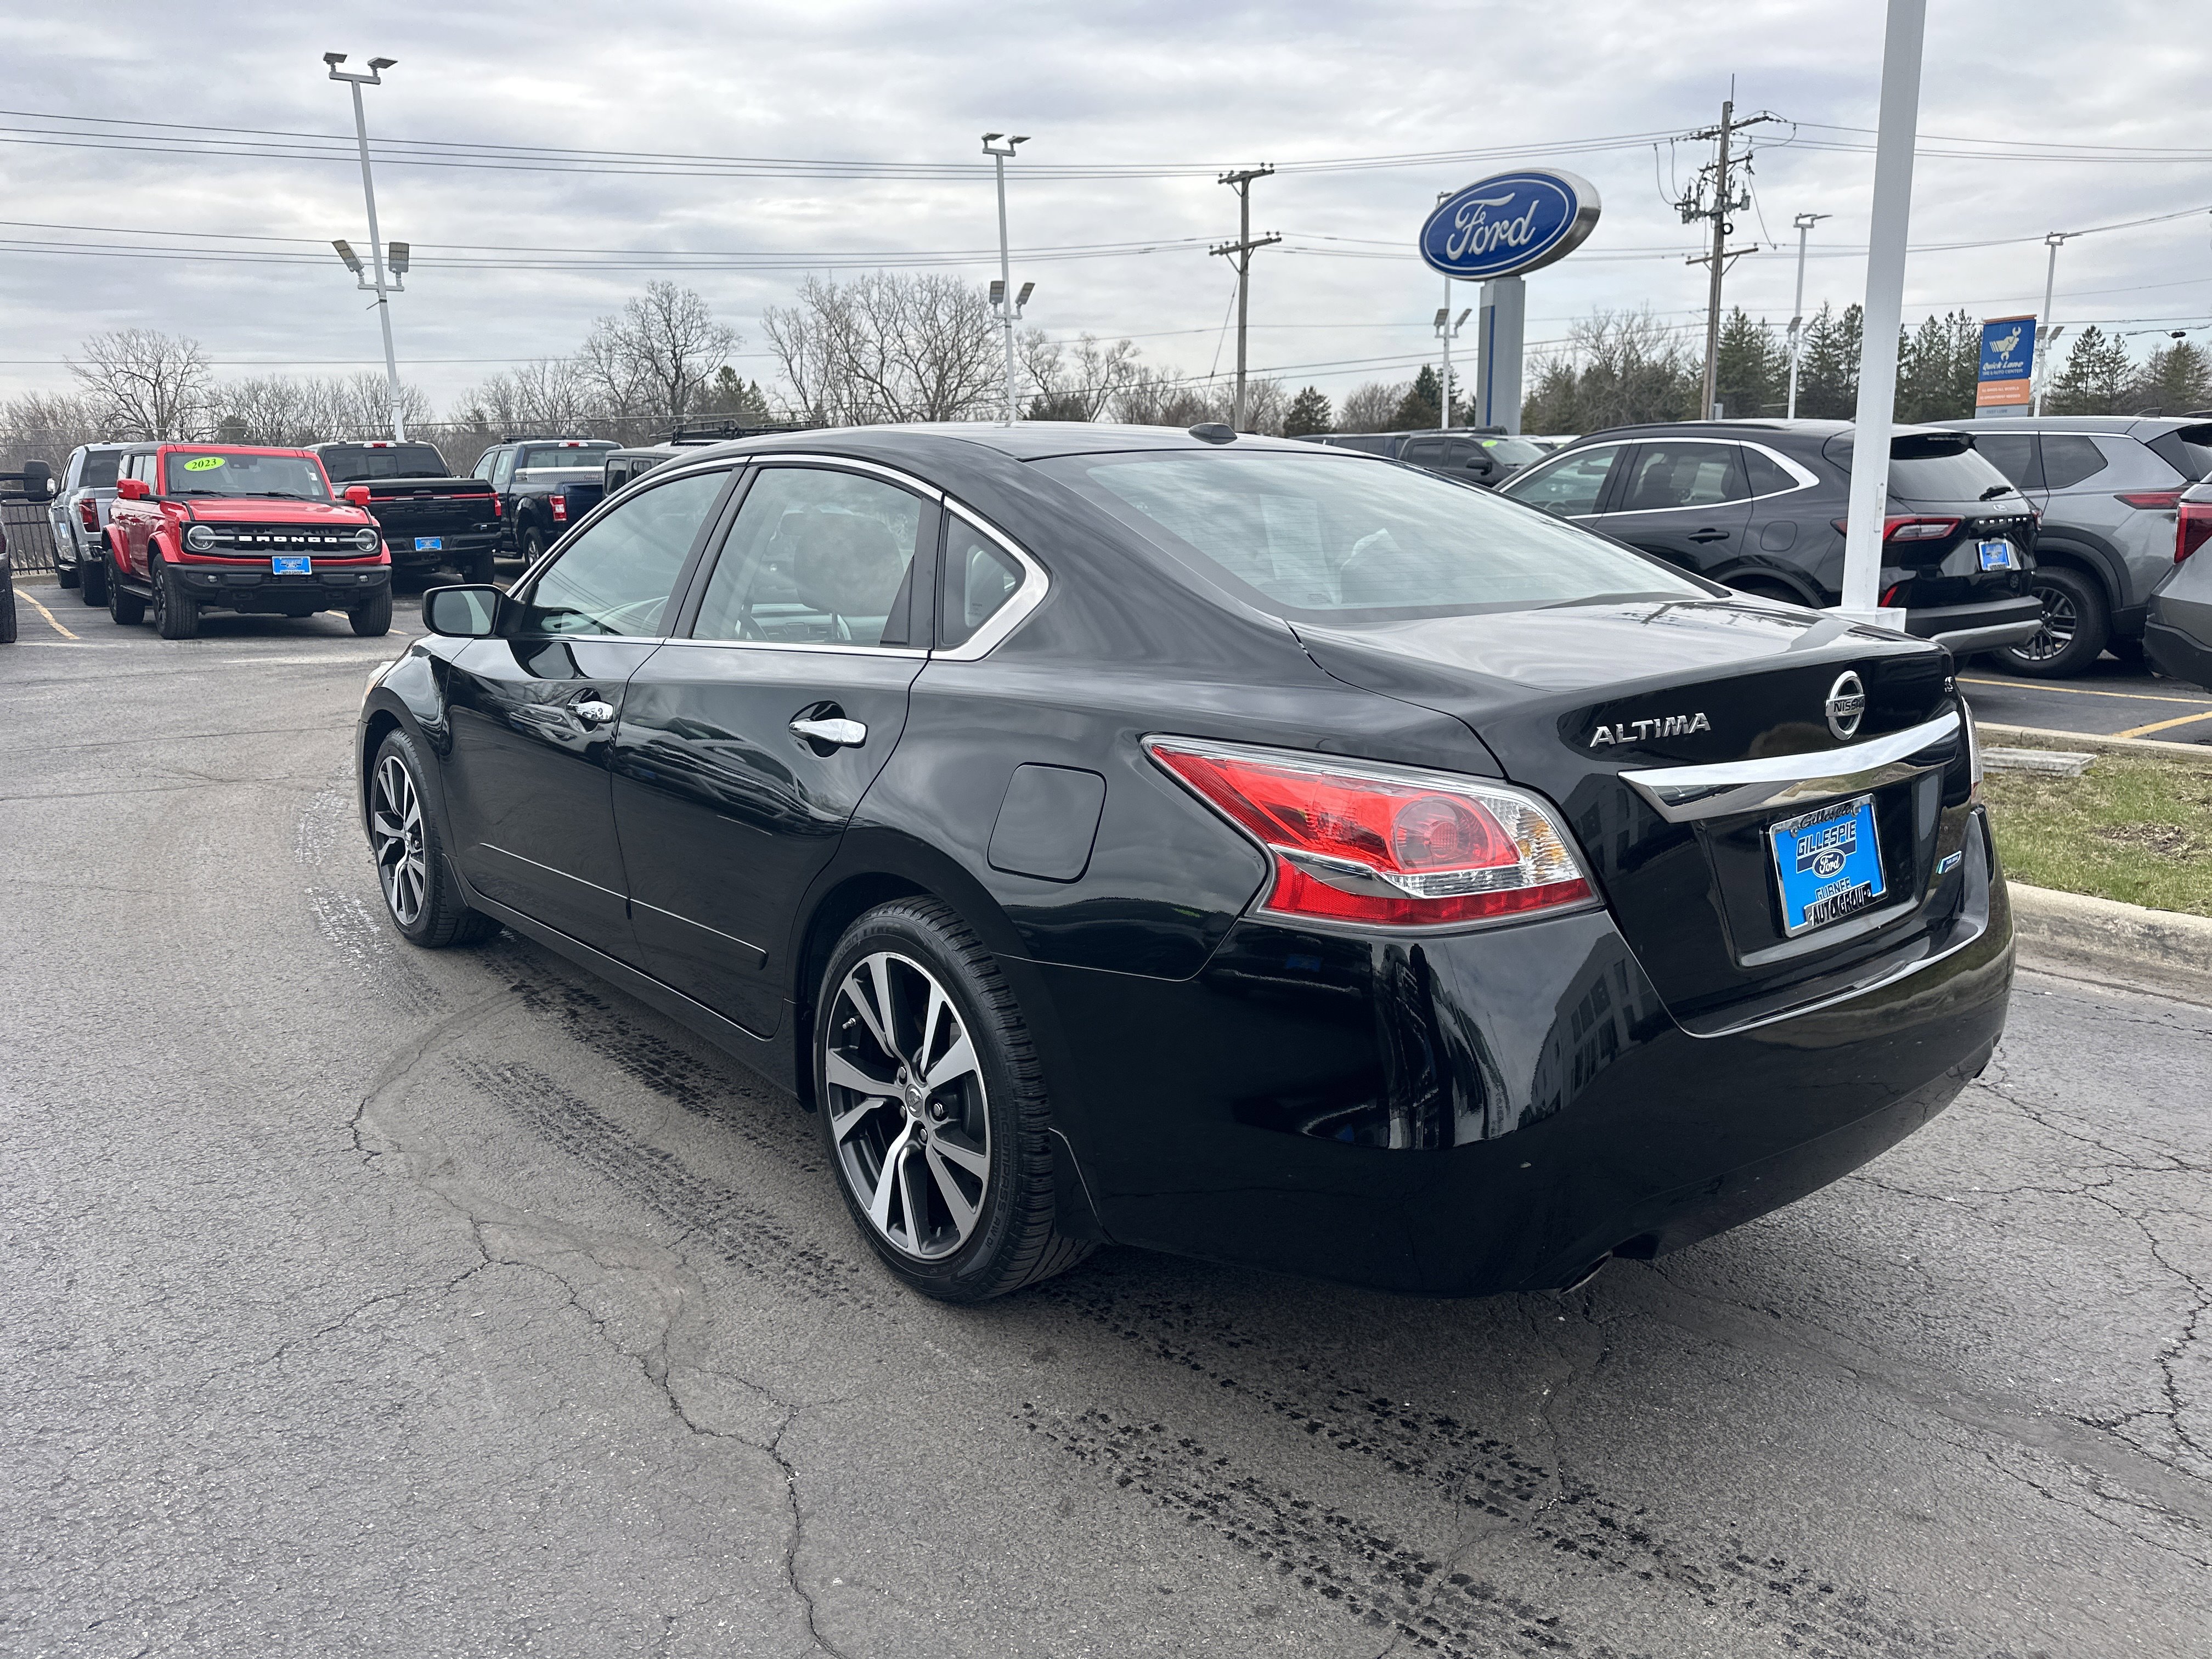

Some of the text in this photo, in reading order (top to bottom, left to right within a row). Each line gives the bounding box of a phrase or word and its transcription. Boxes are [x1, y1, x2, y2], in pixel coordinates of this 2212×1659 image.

[1446, 192, 1539, 261] Ford
[1983, 362, 2002, 371] Quick
[191, 458, 217, 470] 2023
[1589, 712, 1711, 748] ALTIMA
[1797, 820, 1857, 857] GILLESPIE
[1819, 854, 1840, 874] Ford
[1815, 877, 1852, 901] GURNEE
[1812, 885, 1866, 926] AUTO GROUP
